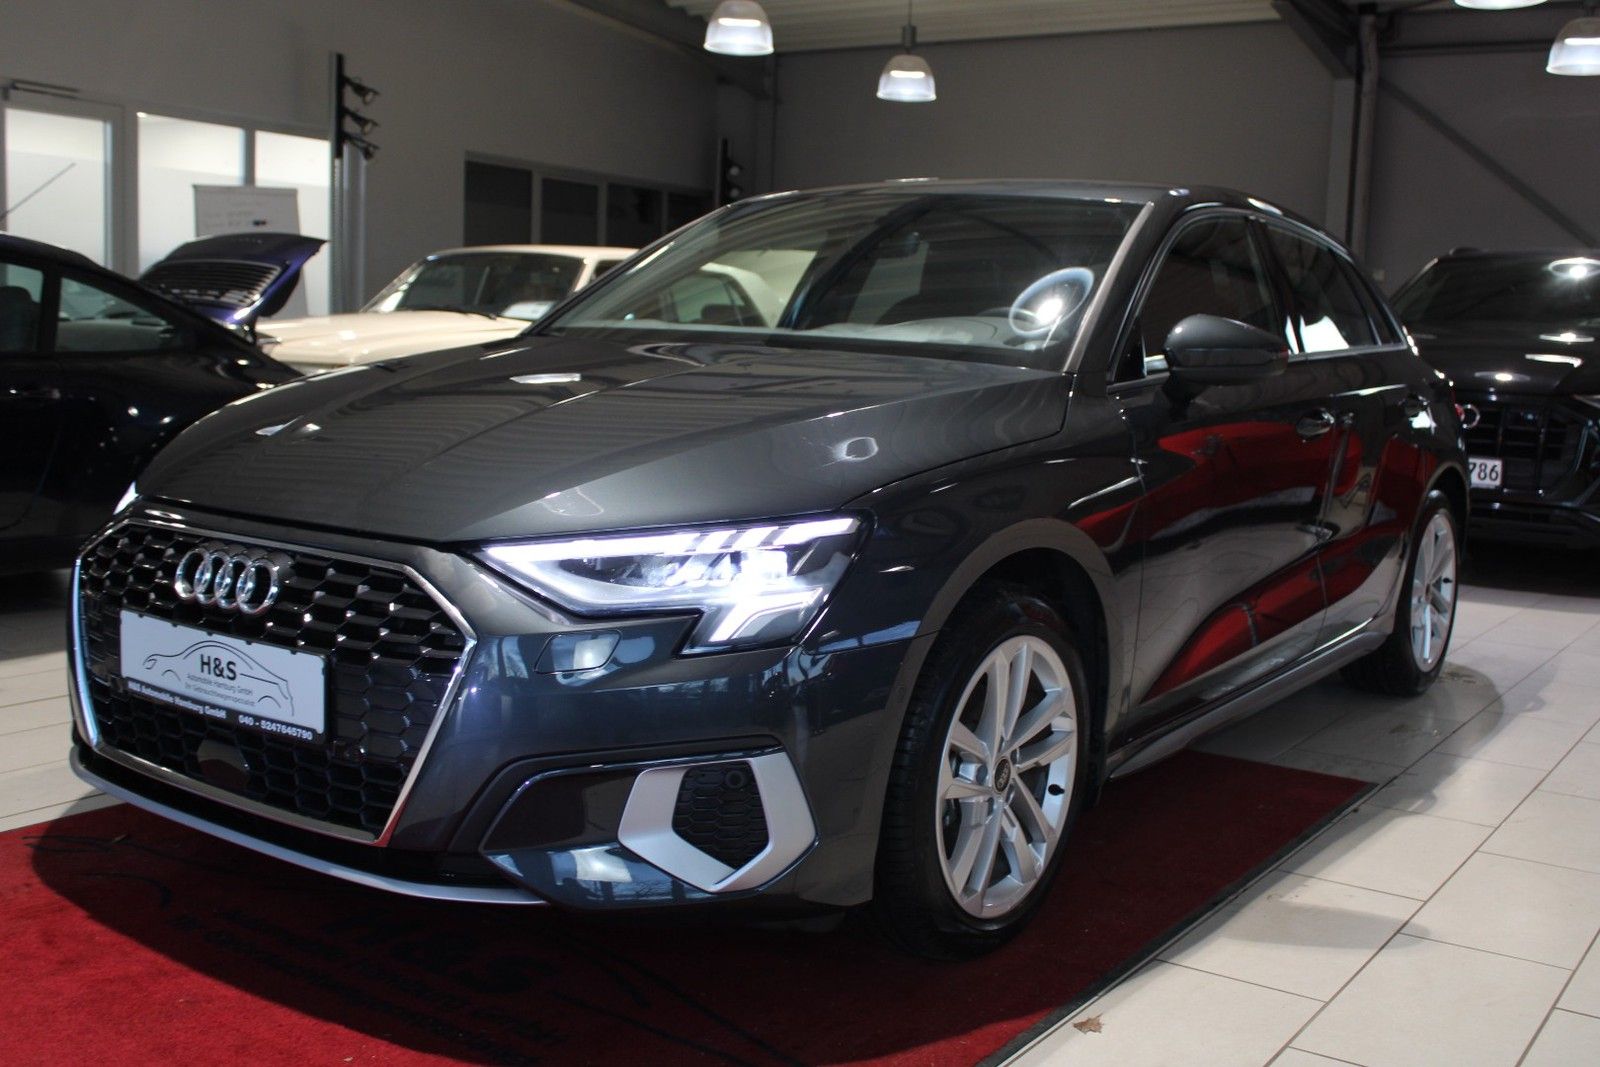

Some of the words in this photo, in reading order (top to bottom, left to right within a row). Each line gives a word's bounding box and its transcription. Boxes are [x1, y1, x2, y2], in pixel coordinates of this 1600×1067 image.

[200, 654, 237, 681] H&S
[205, 705, 226, 719] GmbH
[238, 714, 254, 726] 040
